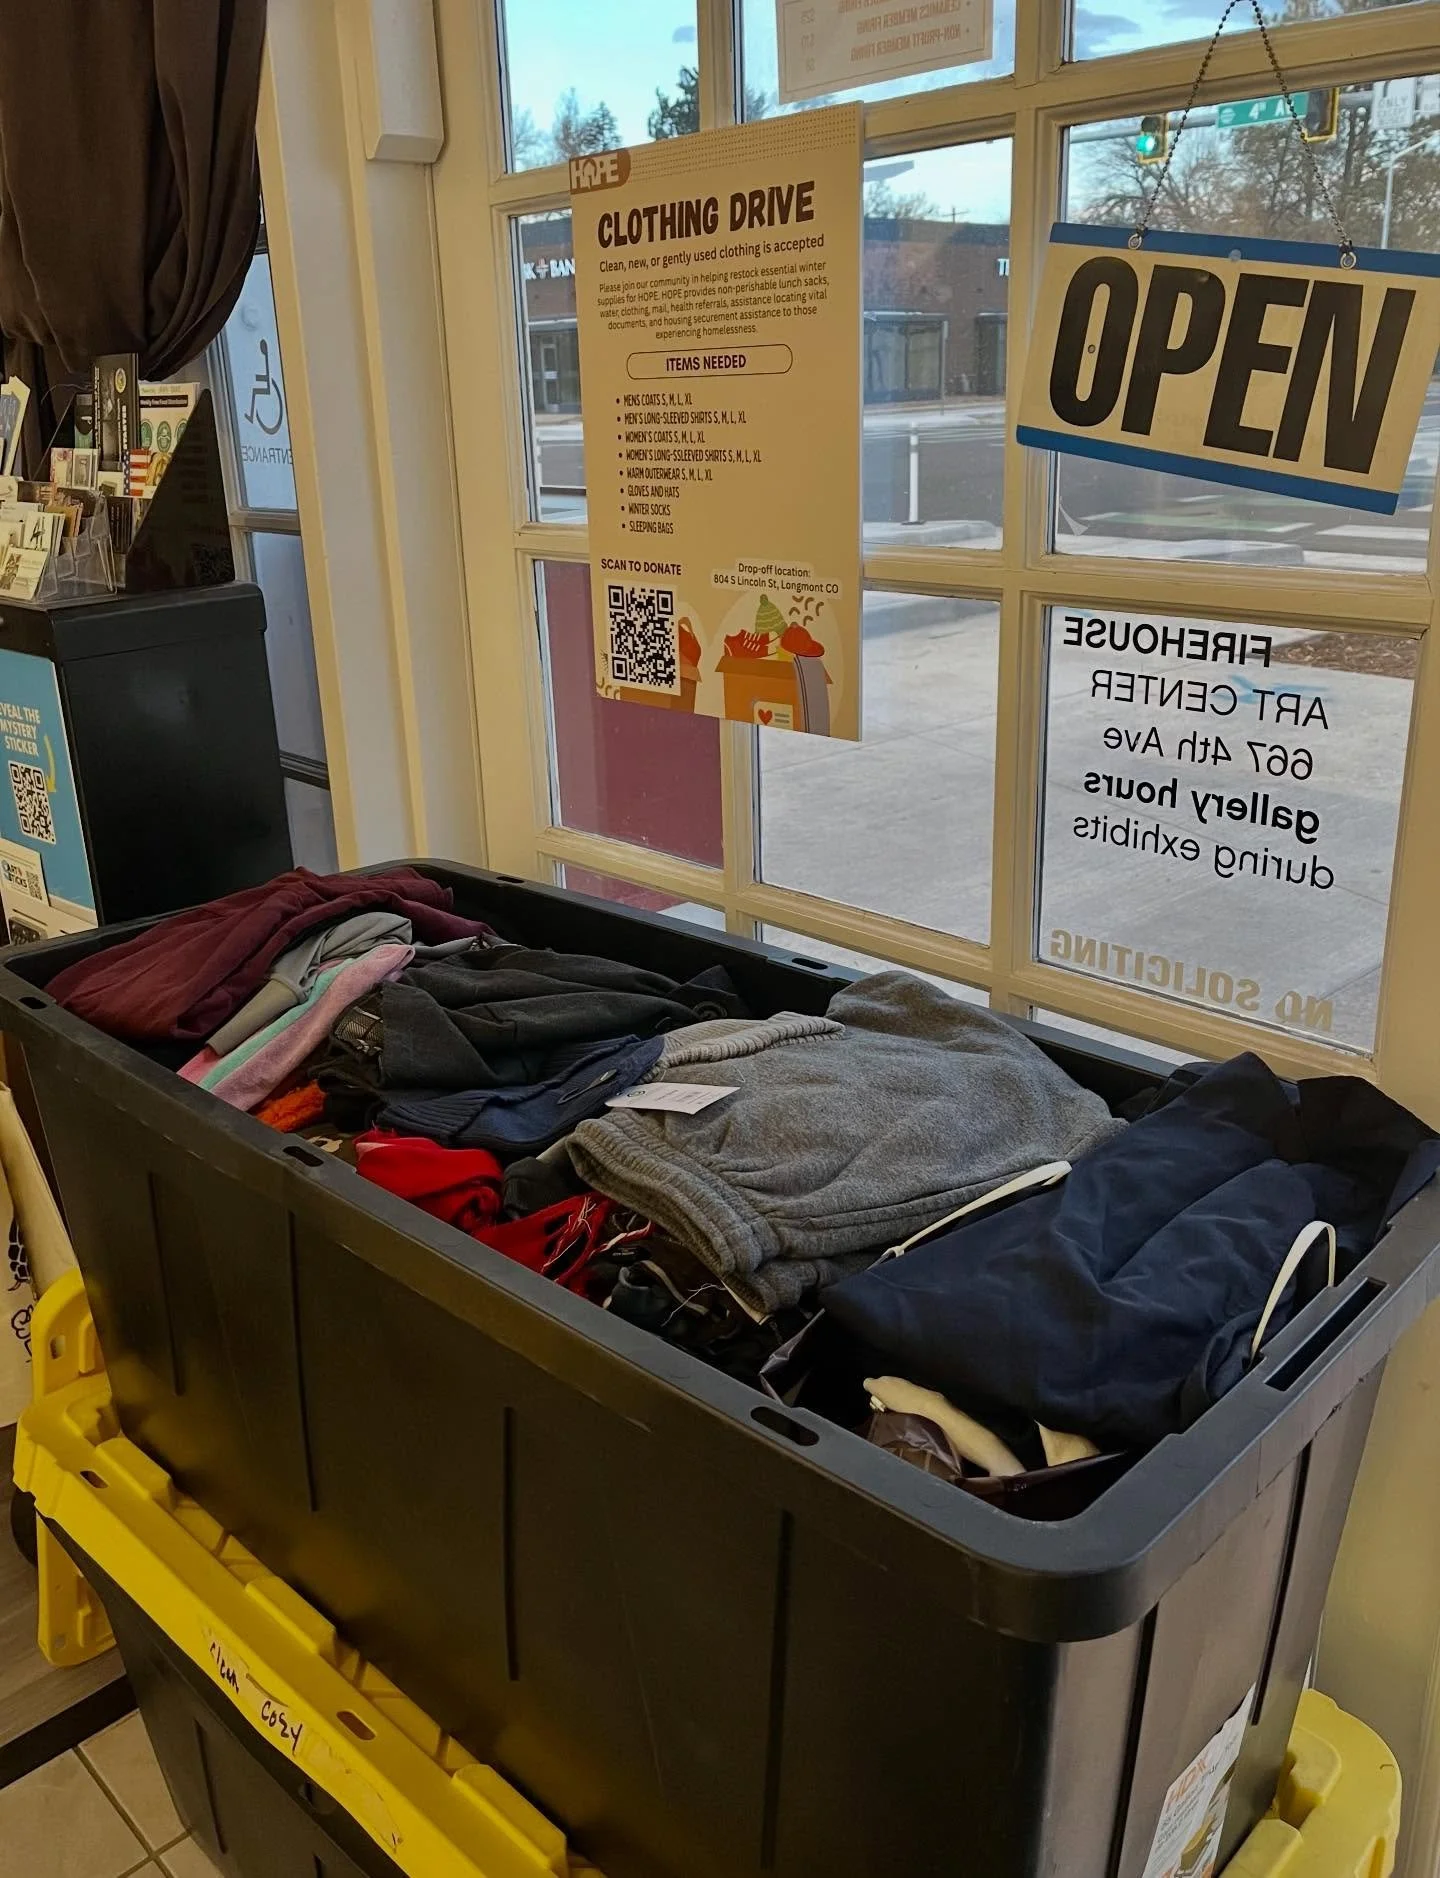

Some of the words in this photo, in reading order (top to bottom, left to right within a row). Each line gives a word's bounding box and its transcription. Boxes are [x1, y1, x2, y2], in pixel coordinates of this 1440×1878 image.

[570, 152, 619, 190] HOPE
[598, 197, 719, 249] CLOTHING
[729, 180, 815, 232] DRIVE
[600, 260, 627, 273] Clean,
[628, 260, 649, 270] new,
[650, 257, 661, 267] or
[662, 252, 692, 269] gently
[694, 247, 717, 262] used
[720, 242, 761, 258] clothing
[763, 240, 772, 254] is
[774, 233, 825, 253] accepted
[599, 283, 621, 293] Please
[622, 281, 635, 294] join
[636, 280, 649, 290] our
[649, 275, 690, 288] community
[691, 274, 699, 283] in
[700, 271, 729, 283] helping
[730, 267, 760, 280] restock
[760, 263, 797, 277] essential
[799, 261, 827, 272] winter
[597, 295, 625, 307] supplies
[626, 293, 637, 304] for
[661, 288, 683, 300] HOPE
[684, 286, 716, 300] provides
[718, 280, 778, 295] non-perishable
[779, 277, 803, 289] lunch
[804, 275, 830, 287] sacks,
[621, 306, 651, 317] clothing,
[651, 304, 670, 314] mail,
[670, 301, 694, 312] health
[695, 298, 729, 310] referrals,
[730, 294, 772, 308] assistance
[773, 291, 807, 304] locating
[808, 289, 828, 301] vital
[607, 319, 648, 330] documents,
[649, 317, 662, 327] and
[663, 315, 692, 326] housing
[693, 311, 738, 324] securement
[739, 308, 781, 320] assistance
[783, 307, 792, 317] to
[793, 304, 818, 316] those
[655, 327, 702, 340] experiencing
[666, 356, 701, 372] ITEMS
[703, 354, 747, 370] NEEDED
[1050, 256, 1416, 475] OPEN
[641, 393, 660, 406] COATS
[685, 393, 693, 406] XL
[644, 411, 690, 425] LONG-SLEEVED
[690, 411, 712, 424] SHIRTS
[738, 410, 747, 424] XL
[653, 430, 673, 443] COATS
[697, 430, 705, 443] XL
[704, 449, 727, 463] SHIRTS
[753, 449, 761, 463] XL
[626, 467, 644, 479] WARM
[645, 467, 681, 480] OUTERWEAR
[705, 468, 713, 480] XL
[628, 484, 650, 497] GLOVES
[651, 485, 663, 498] AND
[664, 486, 680, 498] HATS
[628, 503, 650, 515] WINTER
[651, 504, 671, 516] SOCKS
[629, 520, 657, 533] SLEEPING
[657, 522, 674, 534] BAGS
[601, 558, 628, 571] SCAN
[628, 561, 642, 573] TO
[643, 561, 682, 576] DONATE
[738, 563, 773, 575] Drop-off
[775, 566, 811, 578] location:
[714, 574, 729, 584] 804
[731, 575, 736, 585] S
[738, 576, 766, 588] Lincoln
[768, 578, 779, 590] St,
[781, 580, 824, 593] Longmont
[825, 583, 839, 594] CO
[23, 706, 40, 724] THE
[0, 718, 36, 740] MYSTERY
[4, 735, 39, 757] STICKER
